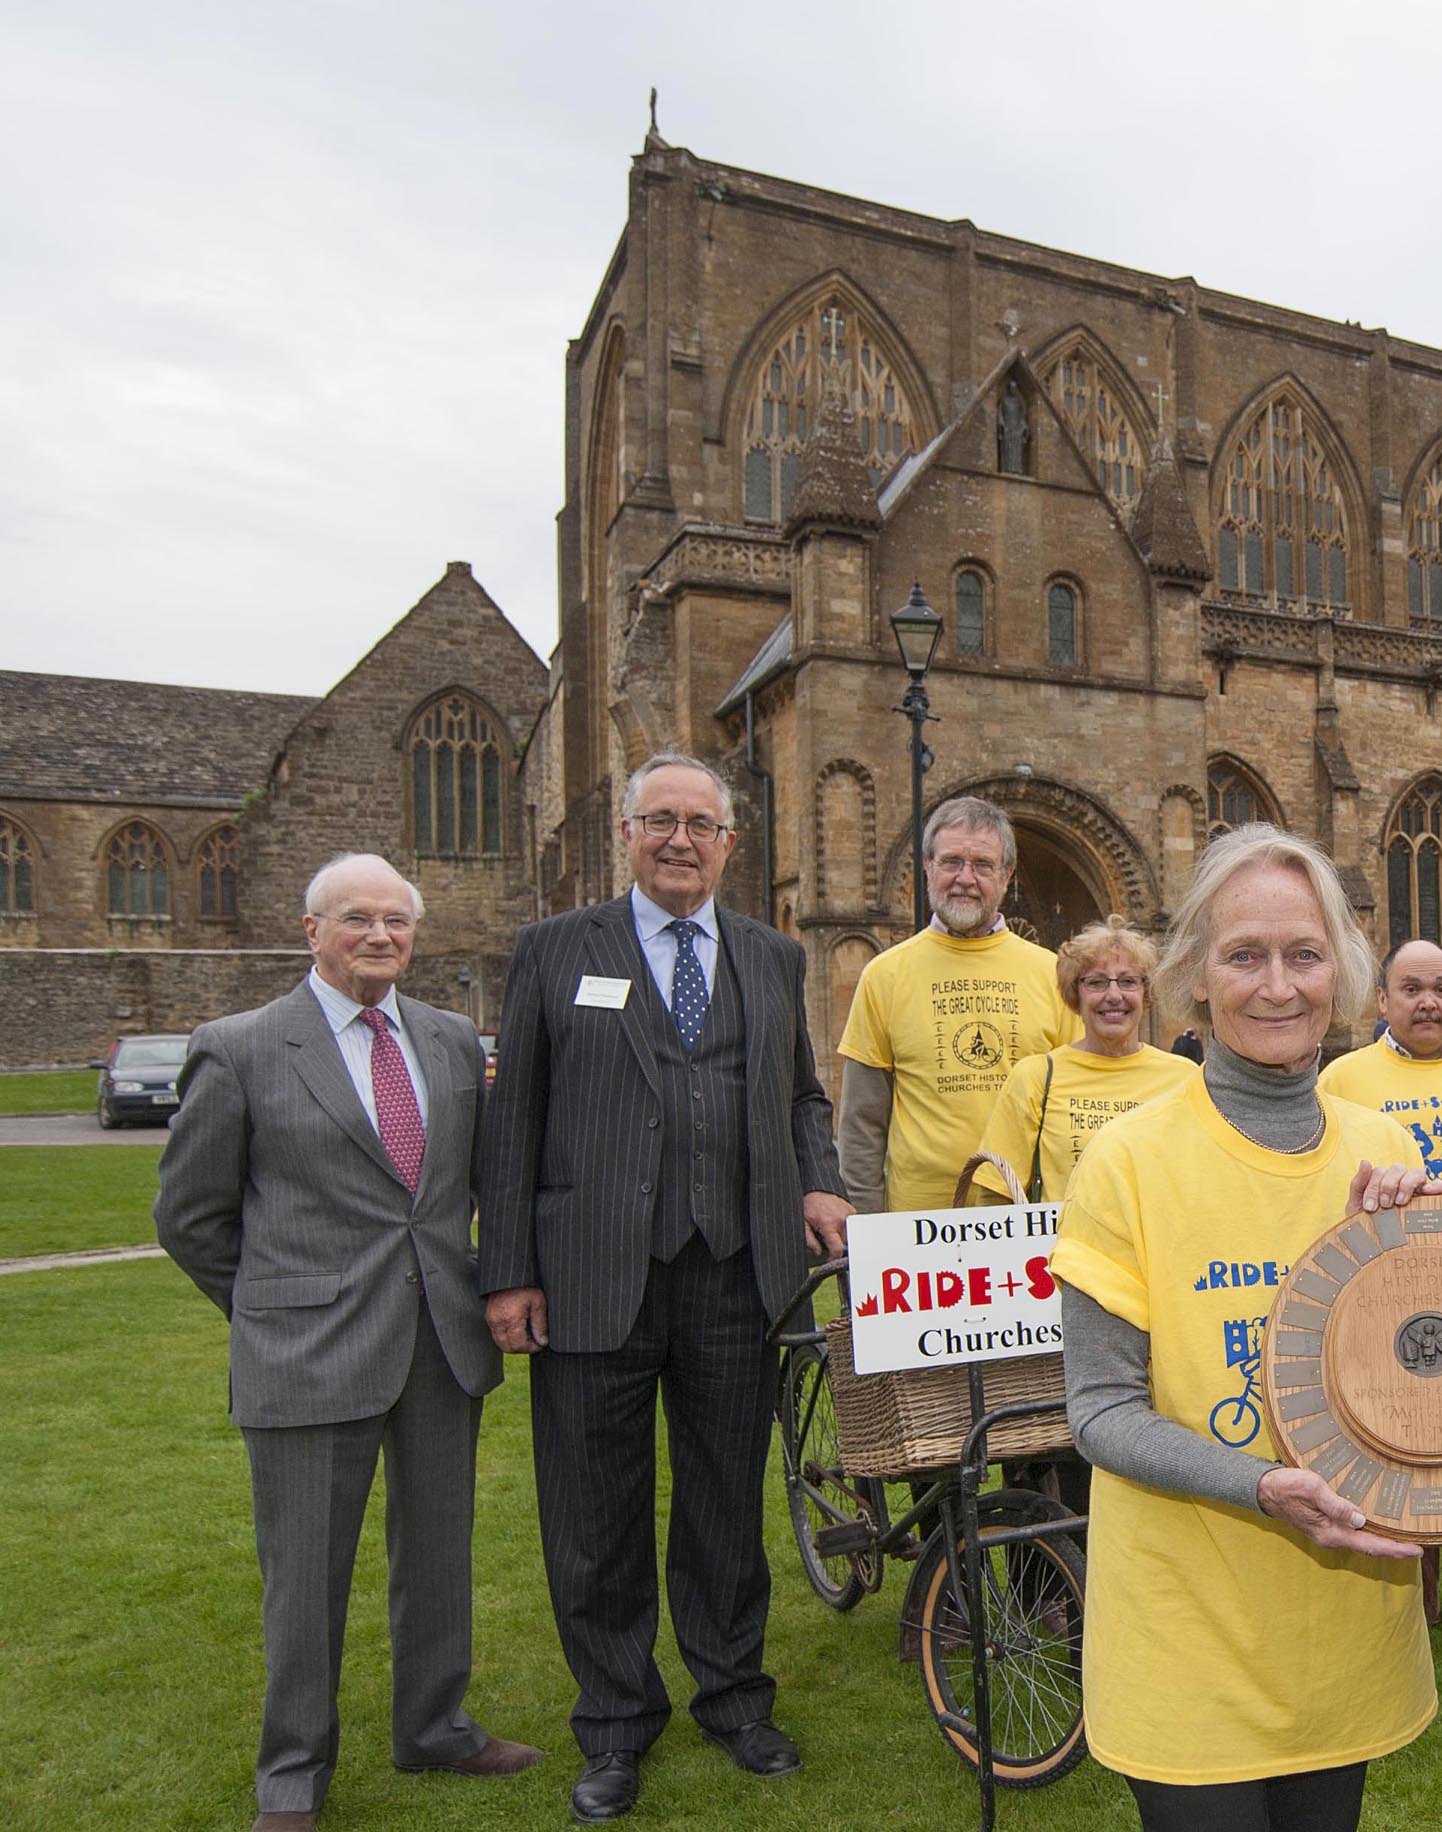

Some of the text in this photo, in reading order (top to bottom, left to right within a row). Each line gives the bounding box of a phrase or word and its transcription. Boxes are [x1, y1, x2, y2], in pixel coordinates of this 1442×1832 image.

[932, 979, 1017, 995] PLEASE SUPPORT
[932, 996, 1019, 1016] THE GREAT CYCLE RIDE
[937, 1074, 977, 1084] DORSET
[937, 1083, 991, 1094] CHURCHES
[1070, 1098, 1143, 1113] PLEASE SUPP
[1070, 1112, 1085, 1130] THE
[913, 1214, 1015, 1246] Dorset
[1357, 1293, 1440, 1308] CHURCHES
[917, 1321, 1063, 1357] Churches
